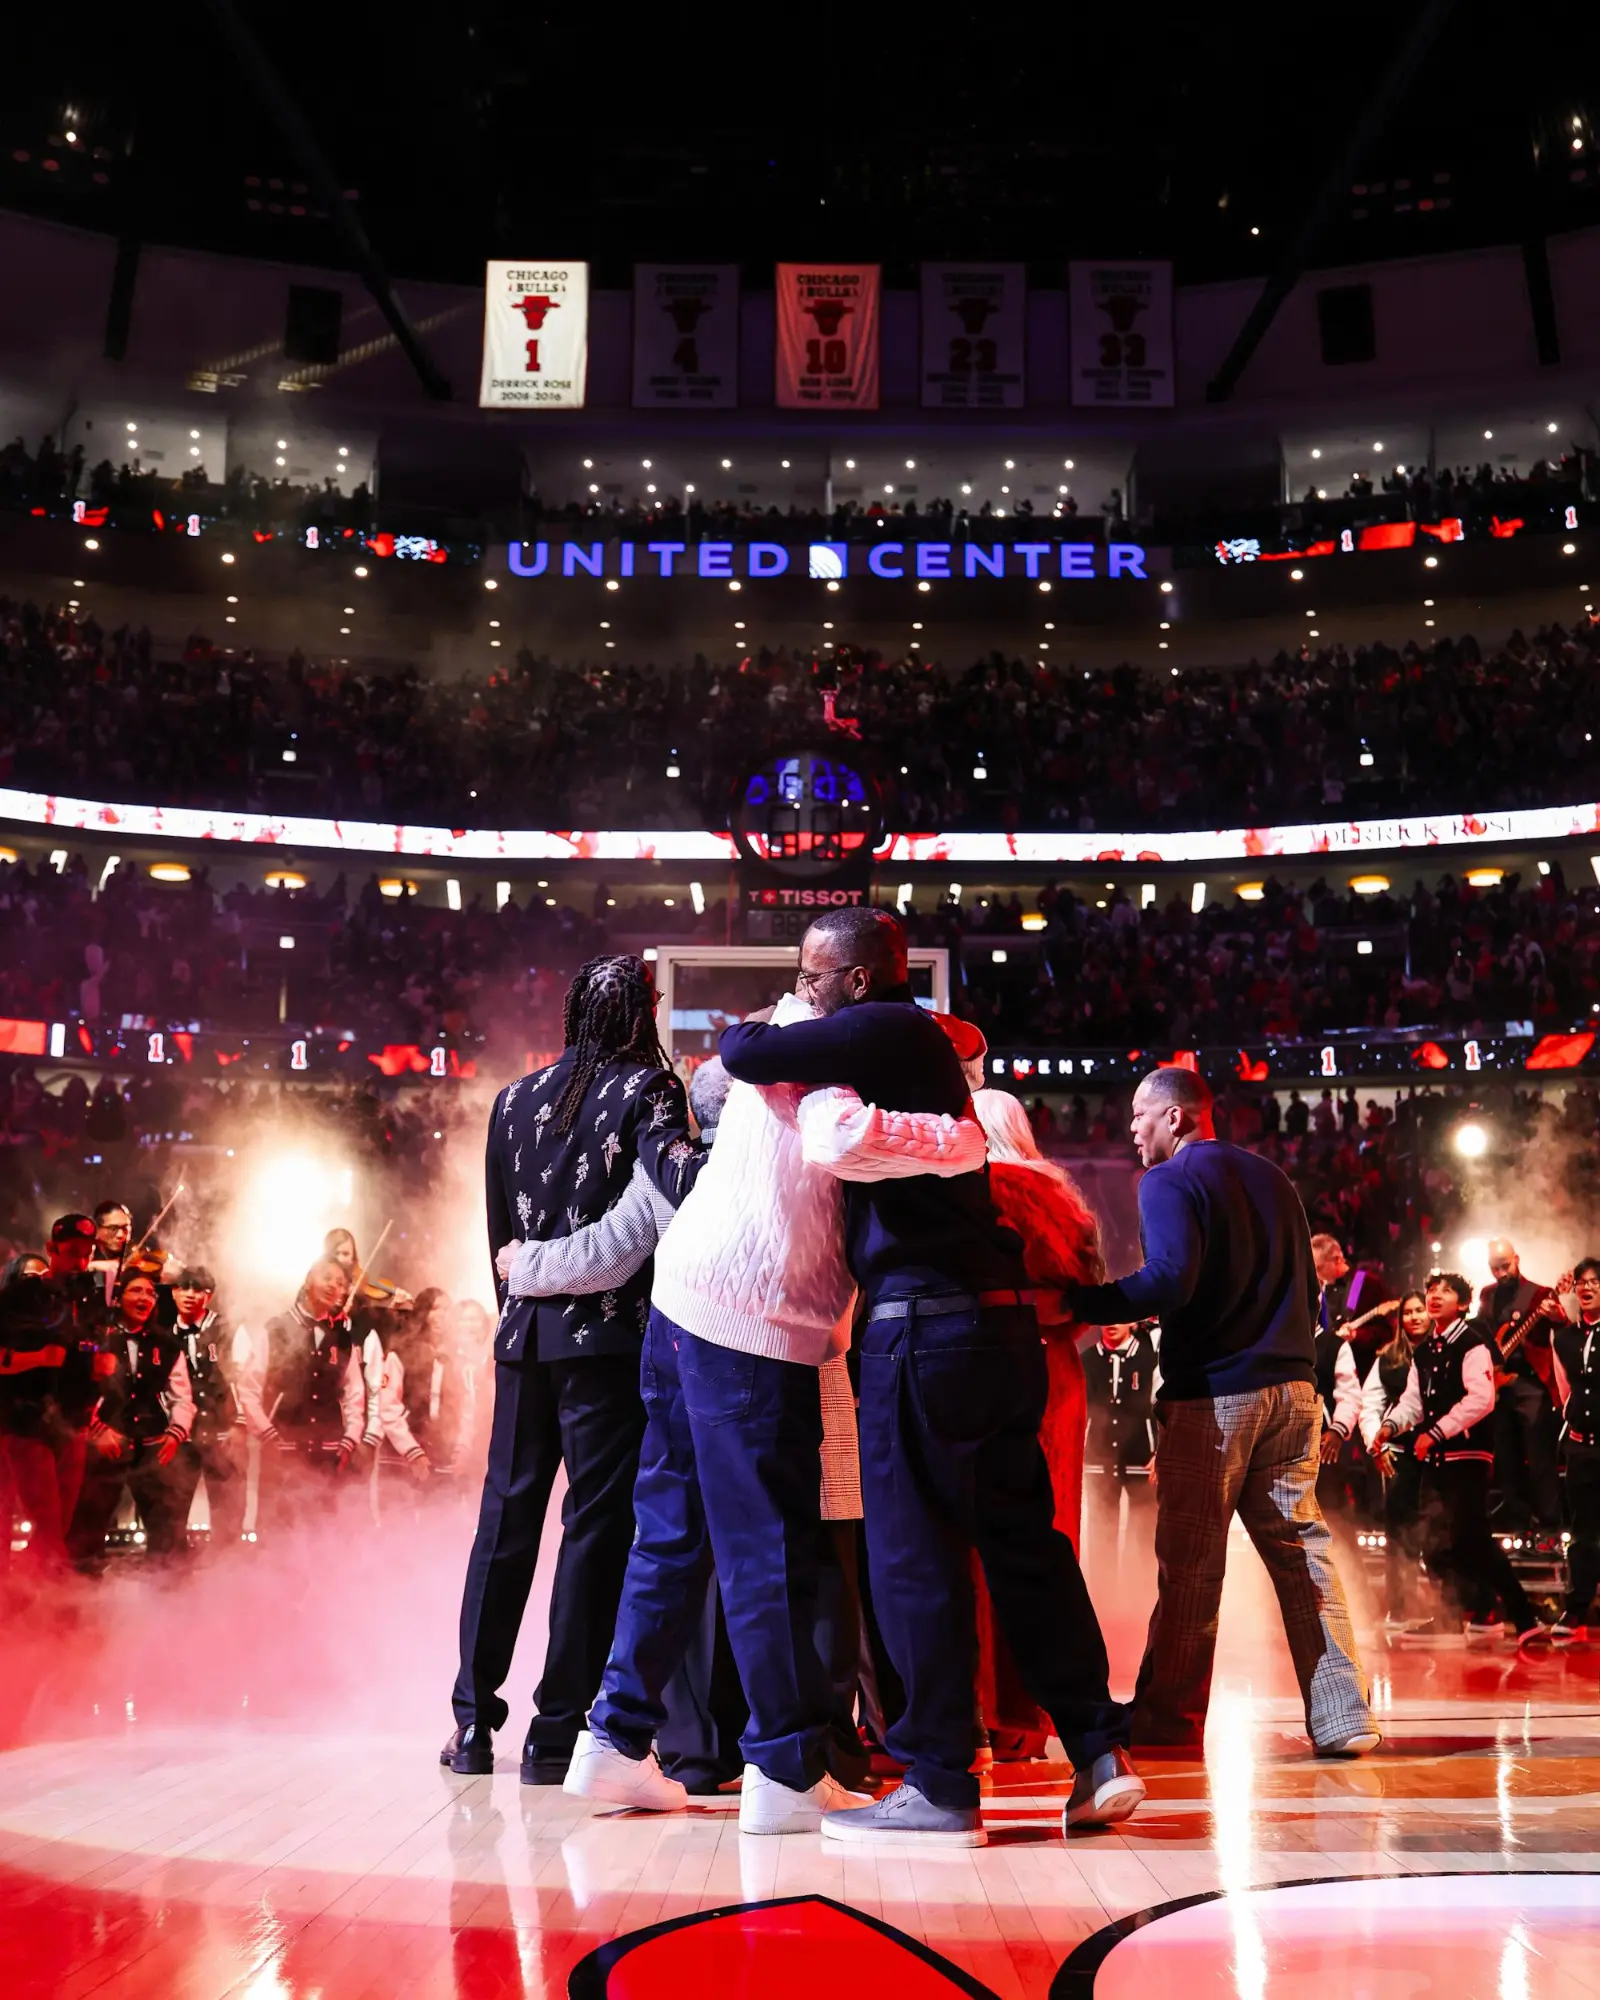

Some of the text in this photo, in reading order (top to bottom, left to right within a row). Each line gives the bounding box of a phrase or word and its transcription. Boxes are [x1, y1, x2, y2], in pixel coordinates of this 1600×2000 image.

[507, 270, 568, 280] CHICAGO
[516, 283, 558, 293] BULLS
[797, 275, 859, 286] CHICAGO
[525, 339, 541, 372] 1
[806, 339, 846, 374] 10
[949, 337, 997, 373] 23
[1098, 332, 1146, 367] 33
[491, 380, 571, 389] DERRICK ROSE
[508, 542, 1148, 579] UNITED CENTER
[779, 889, 863, 906] TISSOT
[148, 1033, 164, 1062] 1
[291, 1040, 307, 1069] 1
[430, 1047, 446, 1076] 1
[1321, 1046, 1336, 1076] 1
[1464, 1041, 1481, 1070] 1
